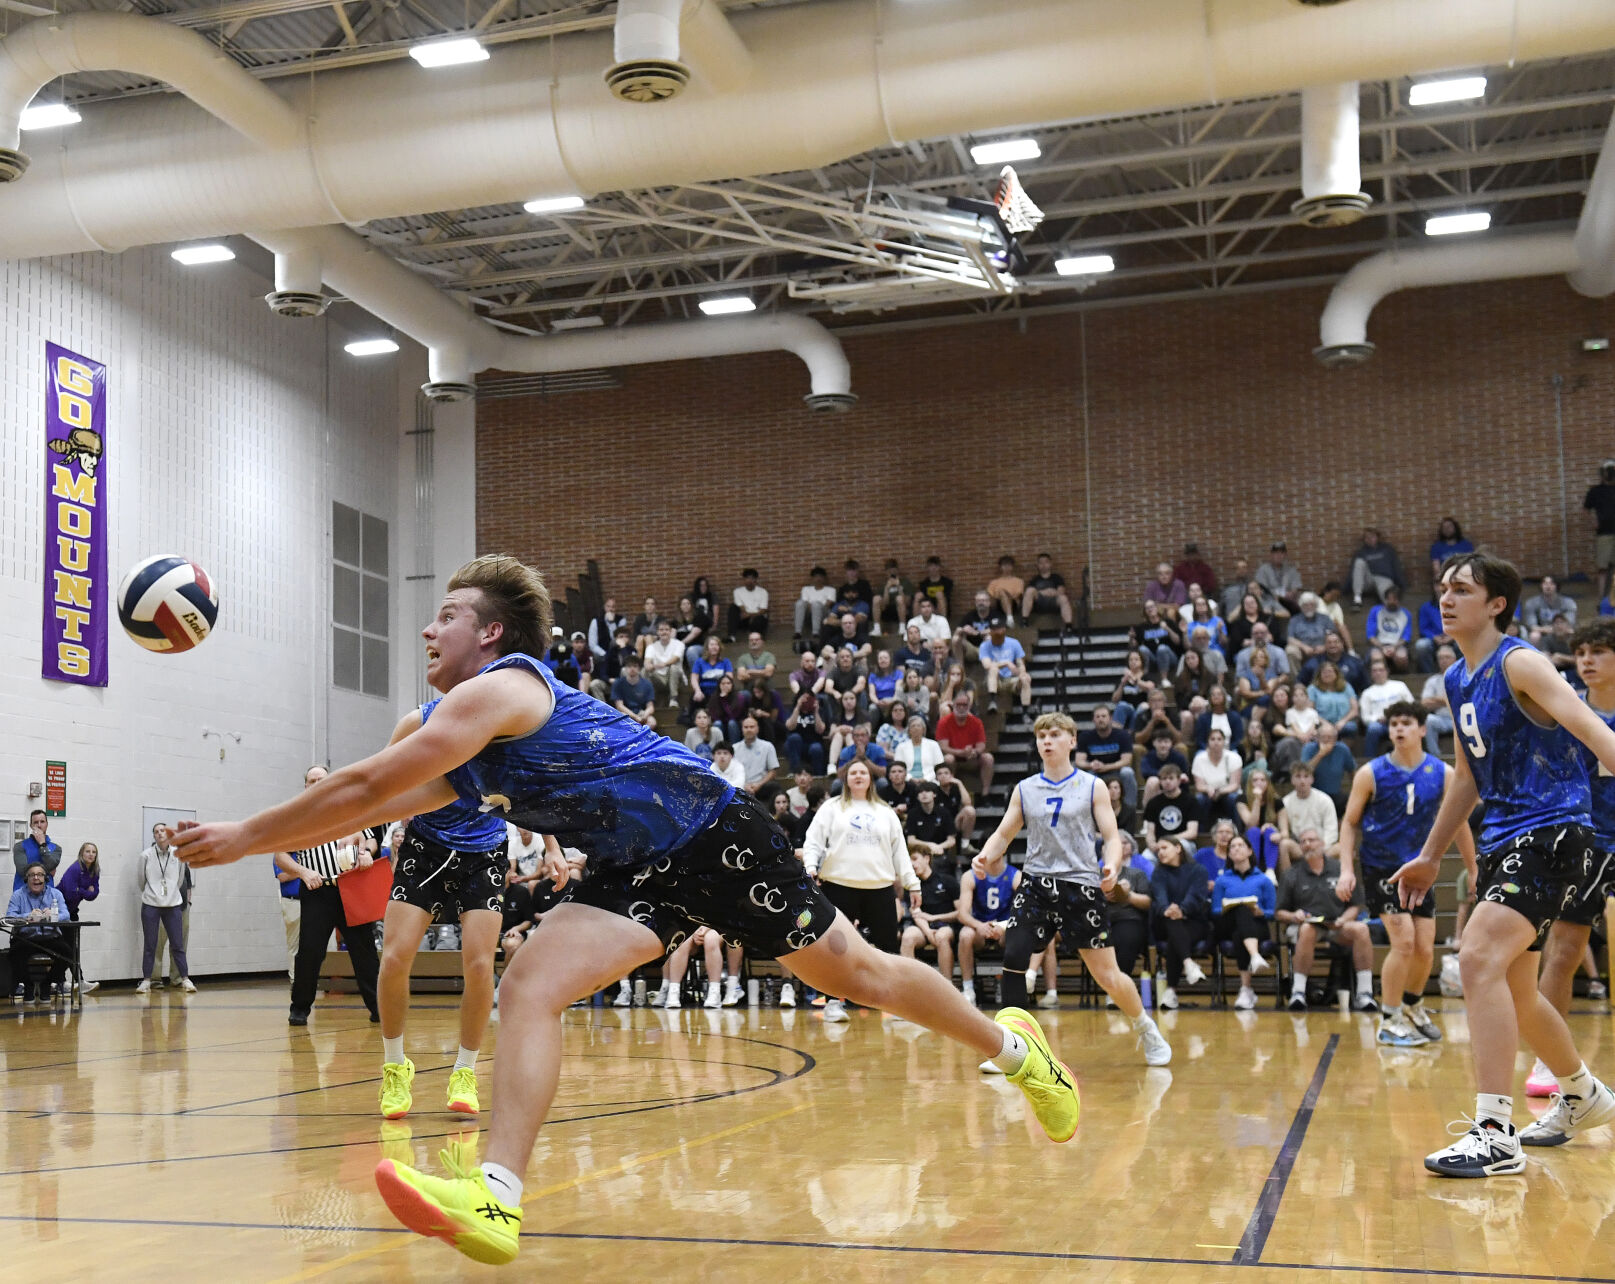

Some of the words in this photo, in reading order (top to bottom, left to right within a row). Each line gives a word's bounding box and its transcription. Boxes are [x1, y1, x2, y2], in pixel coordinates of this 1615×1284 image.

[57, 356, 94, 429] GO
[52, 463, 97, 677] MOUNTS
[1460, 702, 1487, 758] 9
[1046, 797, 1063, 827] 7
[1406, 783, 1415, 815] 1
[722, 843, 760, 871] CC
[749, 881, 788, 913] CC
[987, 887, 1000, 910] 6
